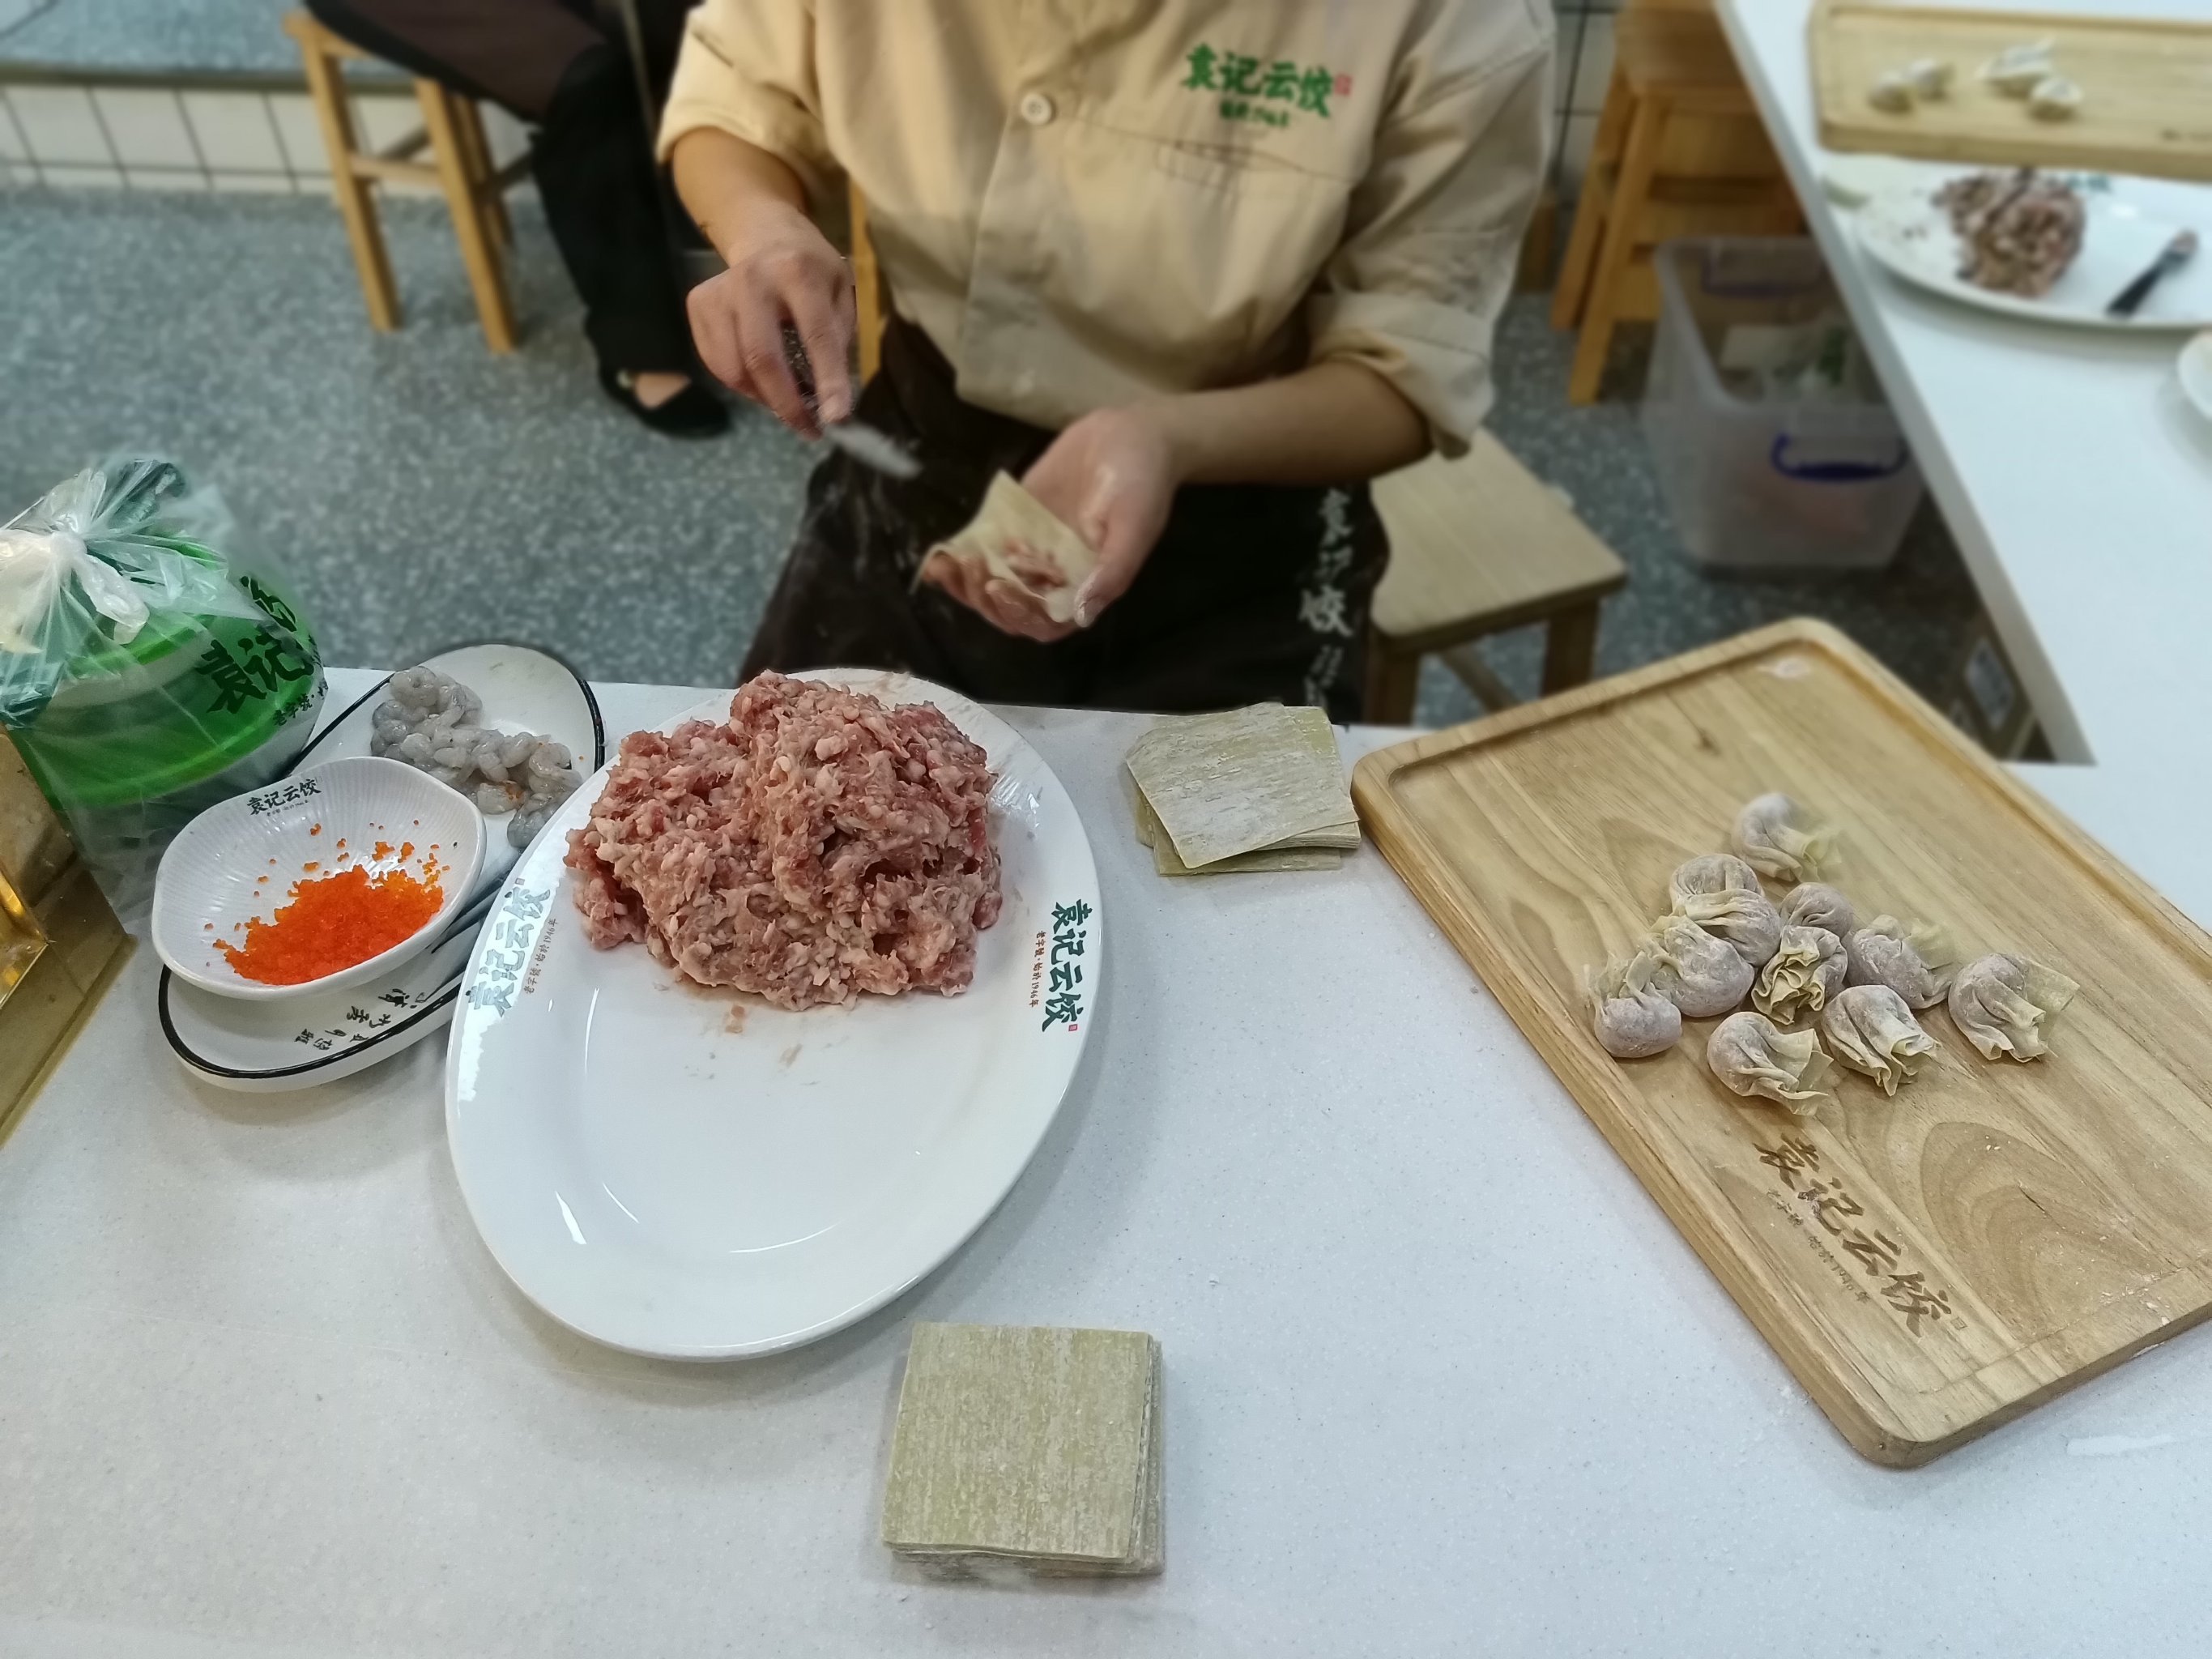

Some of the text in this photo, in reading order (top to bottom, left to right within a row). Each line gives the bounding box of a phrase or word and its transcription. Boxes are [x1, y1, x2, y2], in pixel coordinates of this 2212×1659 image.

[247, 778, 322, 816] 袁记云饺
[466, 886, 551, 1018] 袁记云饺
[1042, 898, 1093, 1032] 袁记云饺
[1754, 1132, 1952, 1338] 袁记云饺
